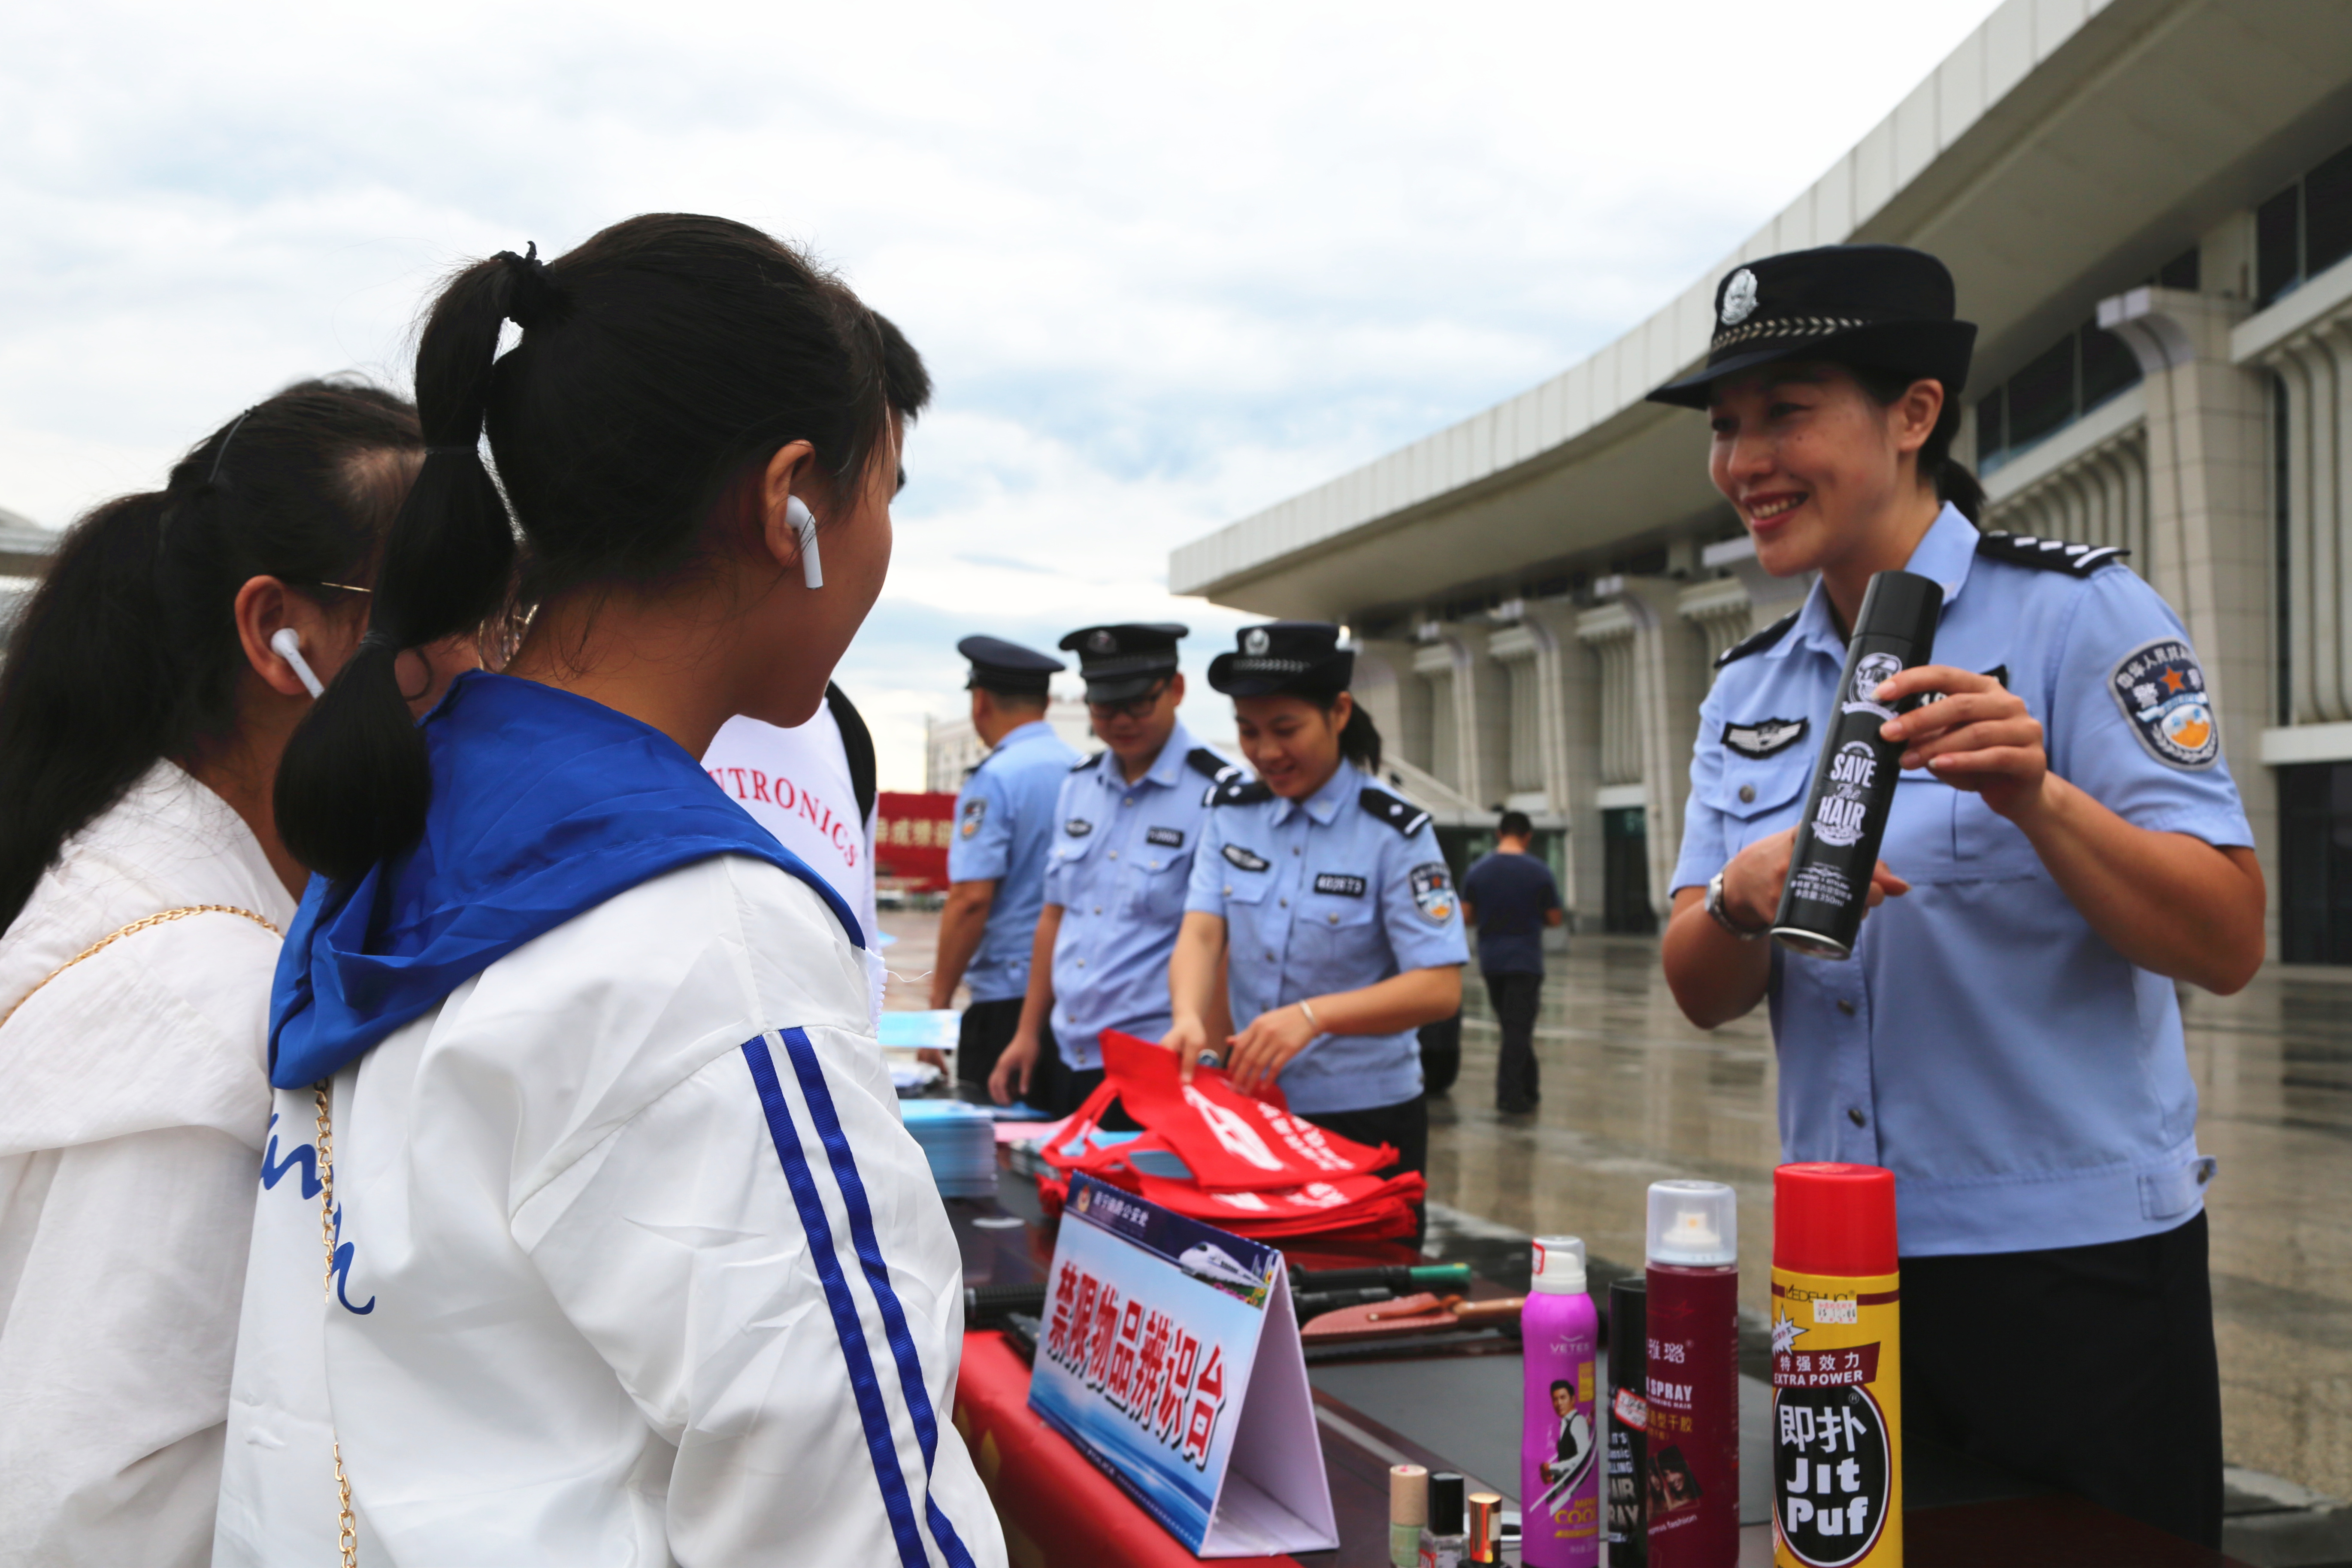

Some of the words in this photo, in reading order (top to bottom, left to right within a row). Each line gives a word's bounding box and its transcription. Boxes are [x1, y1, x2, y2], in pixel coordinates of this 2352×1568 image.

[1830, 753, 1877, 788] SAVE
[1817, 796, 1866, 831] HAIR
[1774, 1372, 1806, 1386] EXTRA
[1809, 1370, 1863, 1386] POWER
[1780, 1352, 1859, 1372] 特强效力
[1651, 1378, 1693, 1402] SPRAY
[1780, 1404, 1867, 1453] 即扑
[1786, 1457, 1861, 1495] Jit
[1787, 1496, 1868, 1536] Puf
